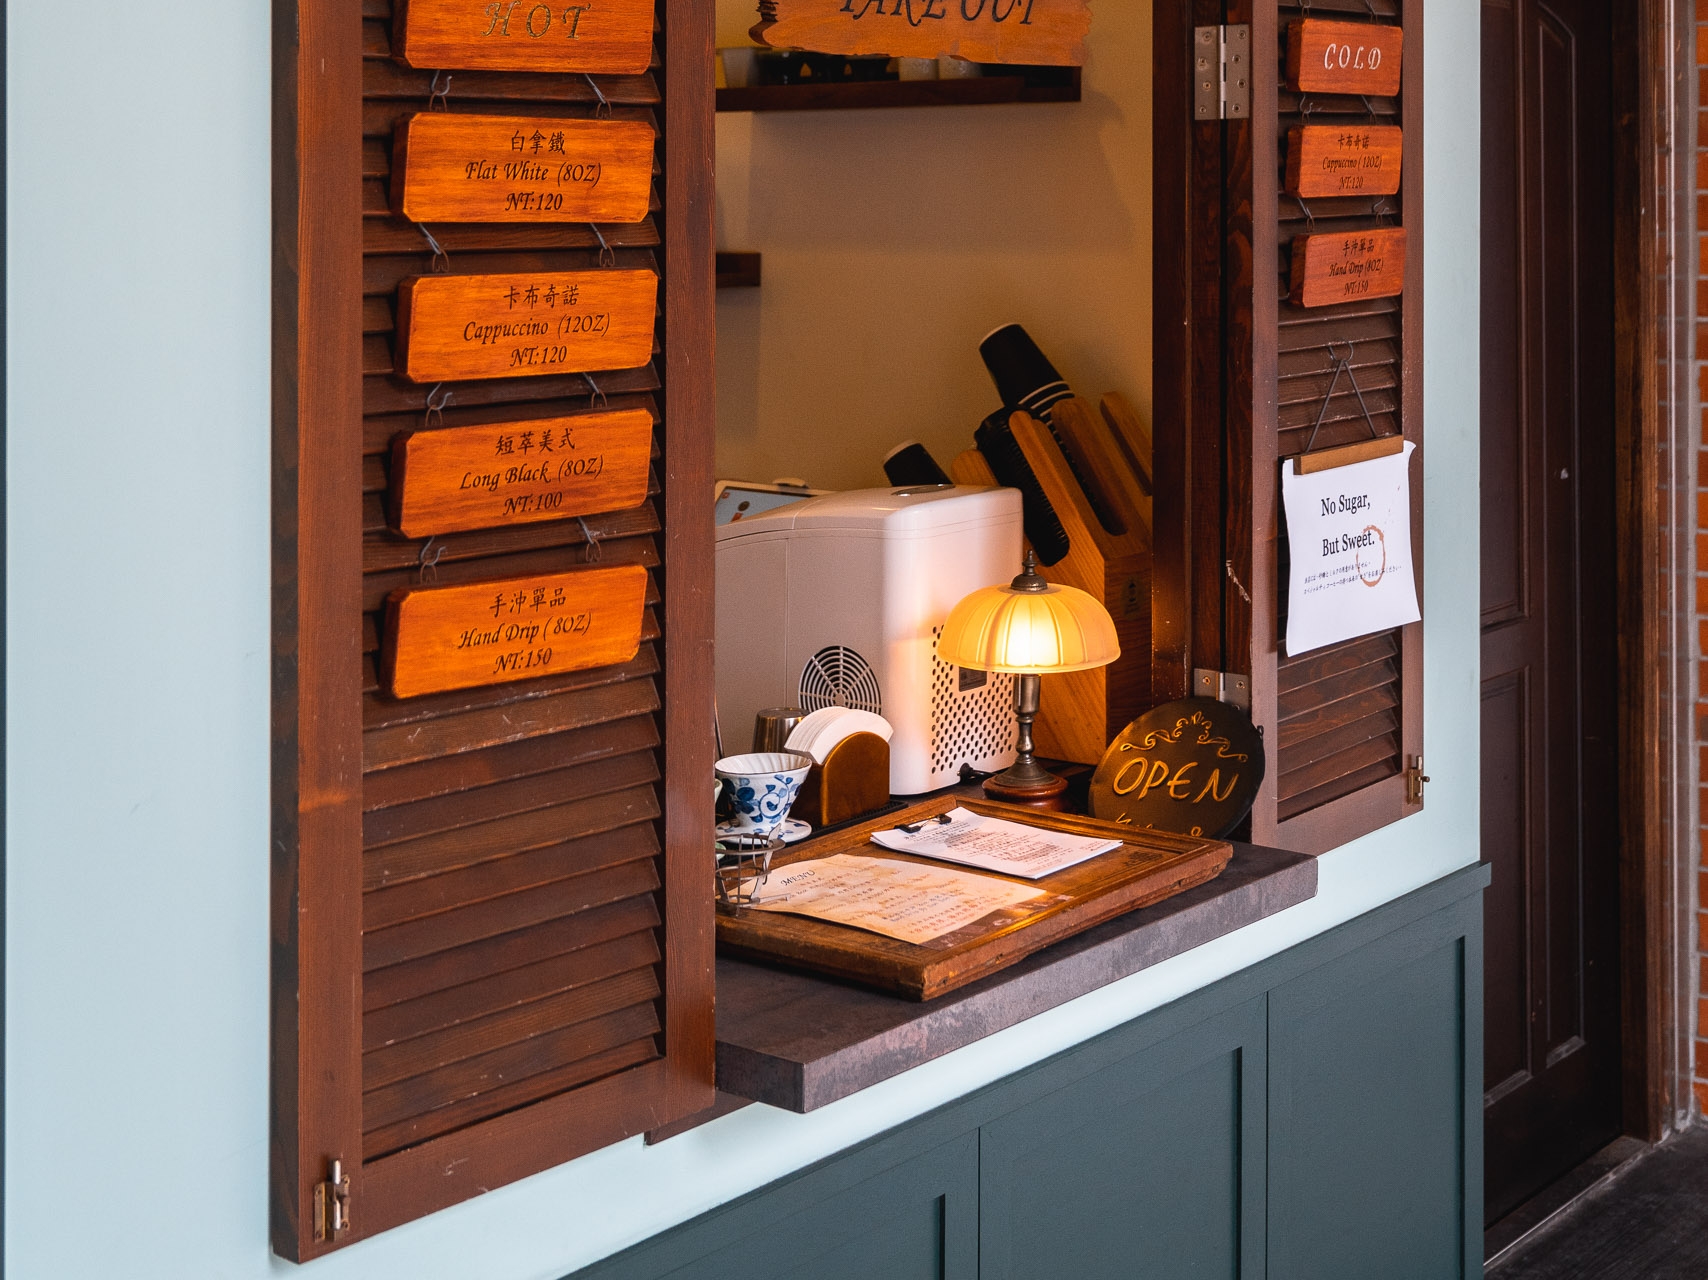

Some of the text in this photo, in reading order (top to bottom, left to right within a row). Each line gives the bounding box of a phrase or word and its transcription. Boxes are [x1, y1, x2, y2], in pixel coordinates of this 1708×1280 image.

[481, 0, 591, 40] HOT
[1324, 43, 1382, 71] COLD
[510, 129, 566, 155] 白拿鐵
[465, 159, 498, 181] Flat
[503, 162, 549, 181] White
[1322, 156, 1357, 173] Cappuccino
[1339, 176, 1363, 190] NT:120
[504, 192, 563, 212] NT:120
[1329, 261, 1349, 277] Hand
[1349, 261, 1364, 277] Drip
[503, 284, 580, 310] 卡布奇諾
[1344, 280, 1369, 296] NT:150
[463, 318, 549, 345] Cappuccino
[510, 346, 568, 367] NT:120
[495, 427, 576, 456] 短萃美式
[459, 471, 499, 491] Long
[504, 460, 551, 484] Black
[503, 492, 563, 516] NT:100
[1321, 493, 1371, 517] No Sugar,
[1322, 530, 1375, 557] But Sweet.
[489, 587, 567, 618] 手沖單品
[459, 623, 504, 649] Hand
[505, 620, 540, 643] Drip
[493, 648, 553, 675] NT:150
[1113, 756, 1239, 804] OPEN
[780, 869, 816, 887] MENU
